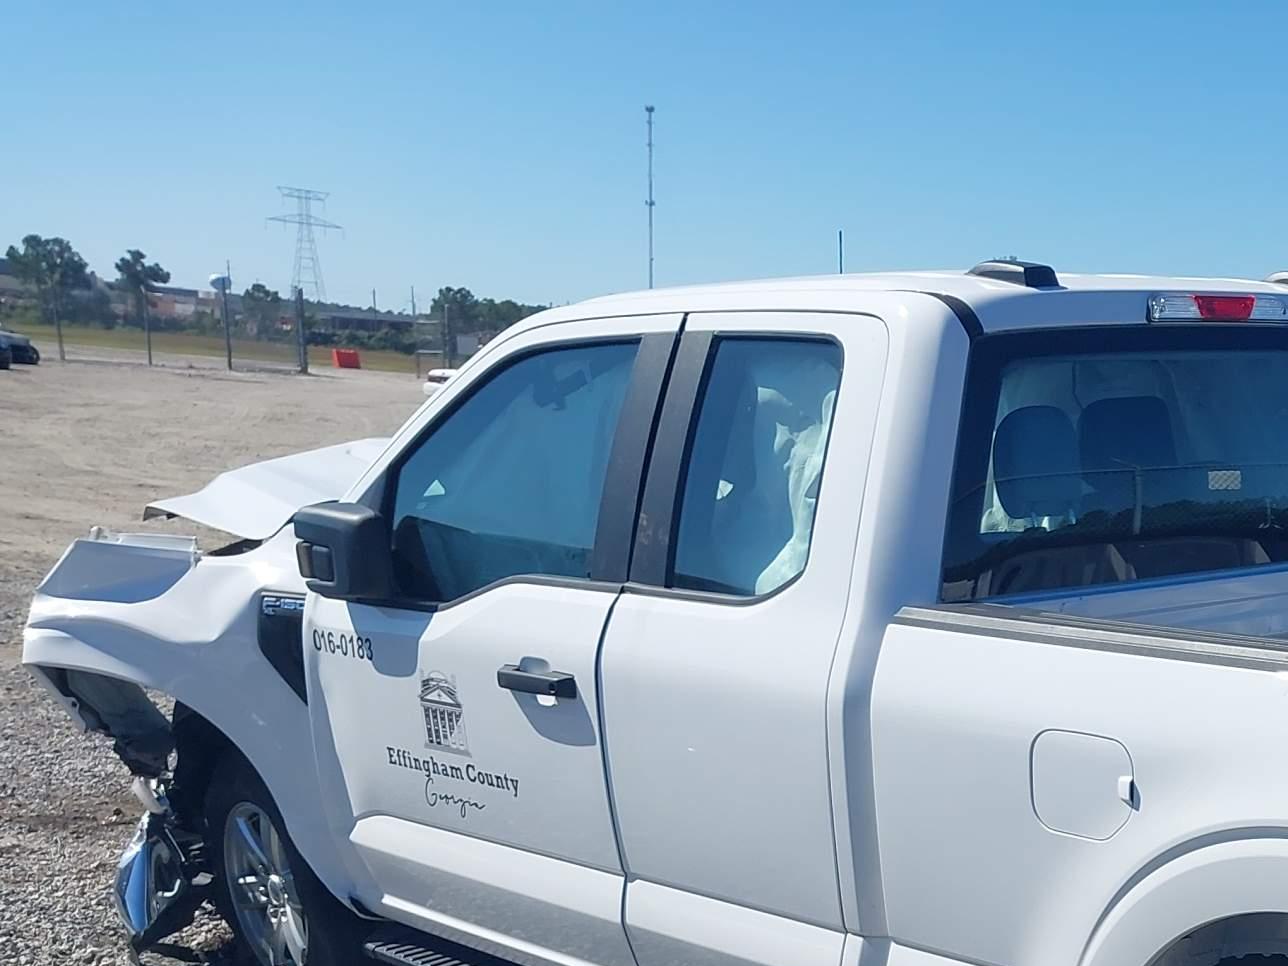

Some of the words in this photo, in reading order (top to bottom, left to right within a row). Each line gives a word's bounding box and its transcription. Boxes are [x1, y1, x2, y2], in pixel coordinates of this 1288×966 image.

[312, 628, 374, 661] 016-0183
[386, 746, 465, 781] Effingham
[466, 764, 519, 798] County
[425, 777, 486, 818] Georgia
